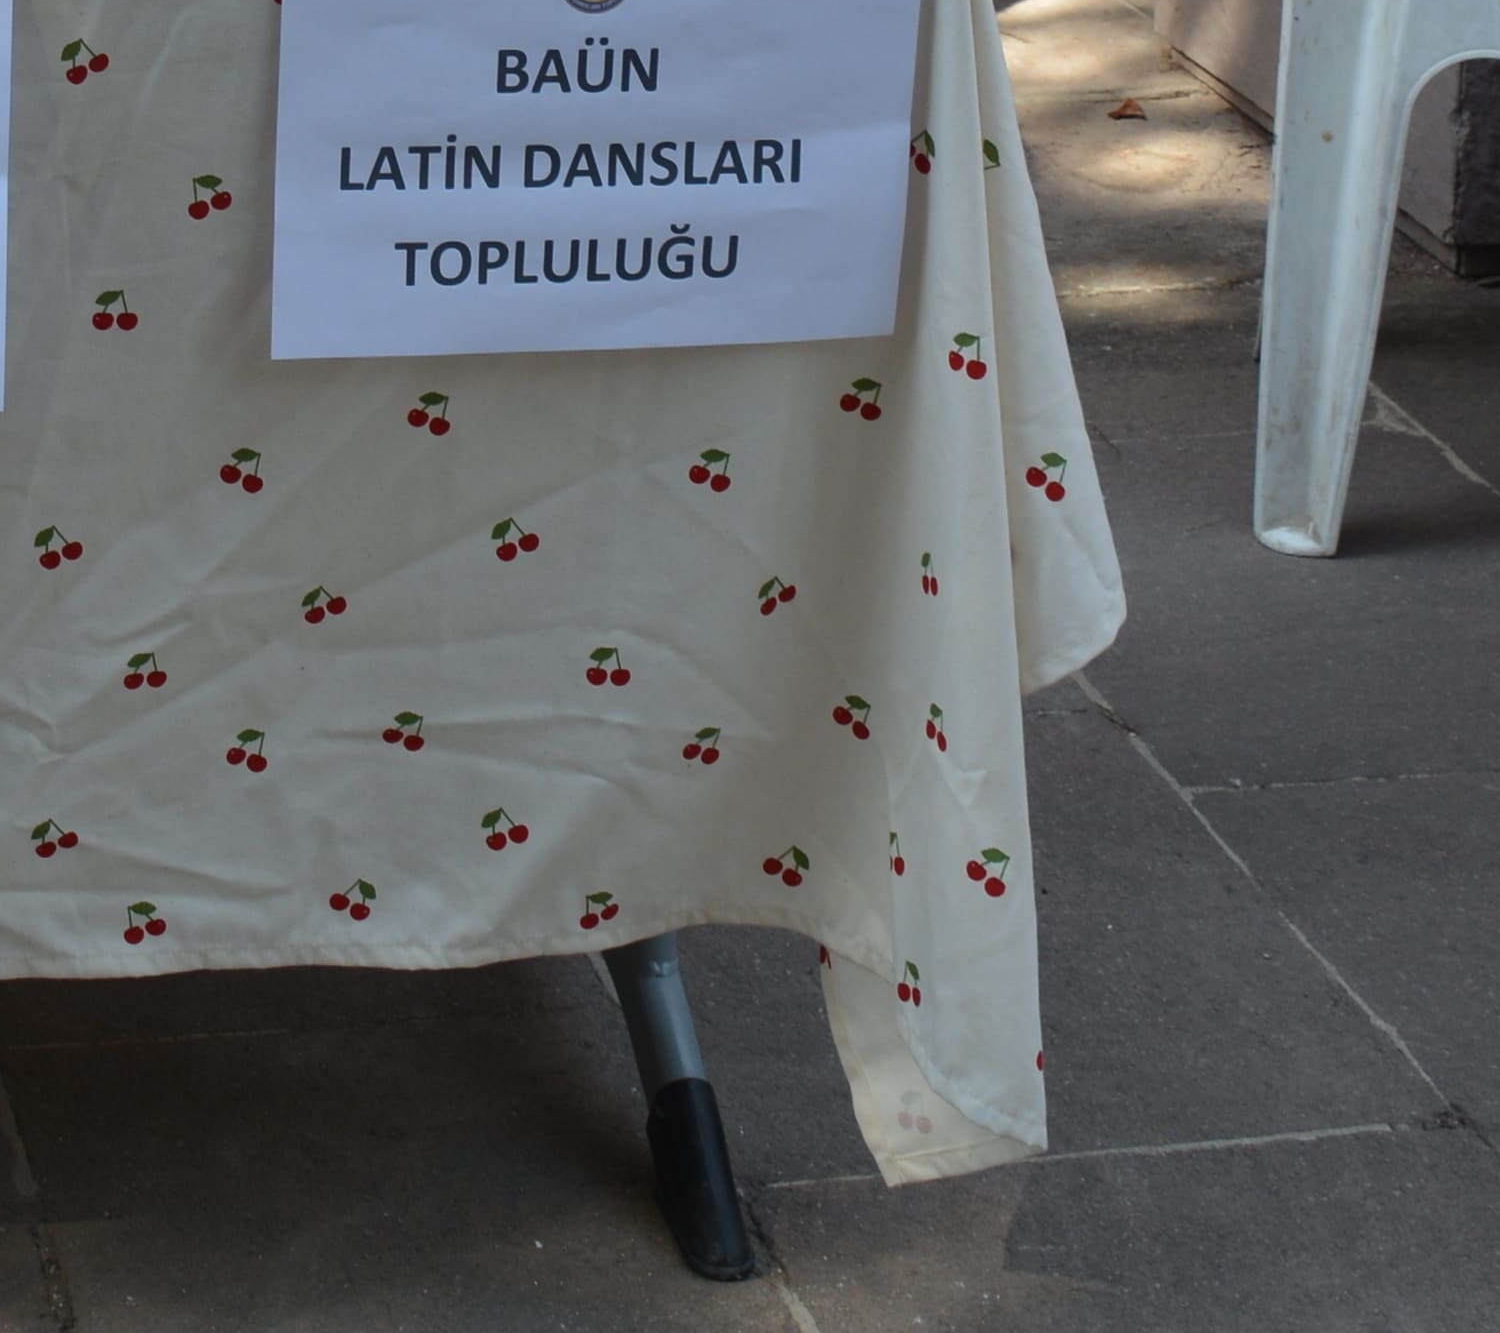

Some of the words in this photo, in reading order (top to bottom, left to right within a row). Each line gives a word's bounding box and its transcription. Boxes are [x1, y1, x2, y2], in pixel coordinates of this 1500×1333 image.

[496, 36, 660, 94] BAÜN
[339, 133, 502, 191] LATİN
[523, 138, 802, 188] DANSLARI
[394, 223, 739, 287] TOPLULUĞU
